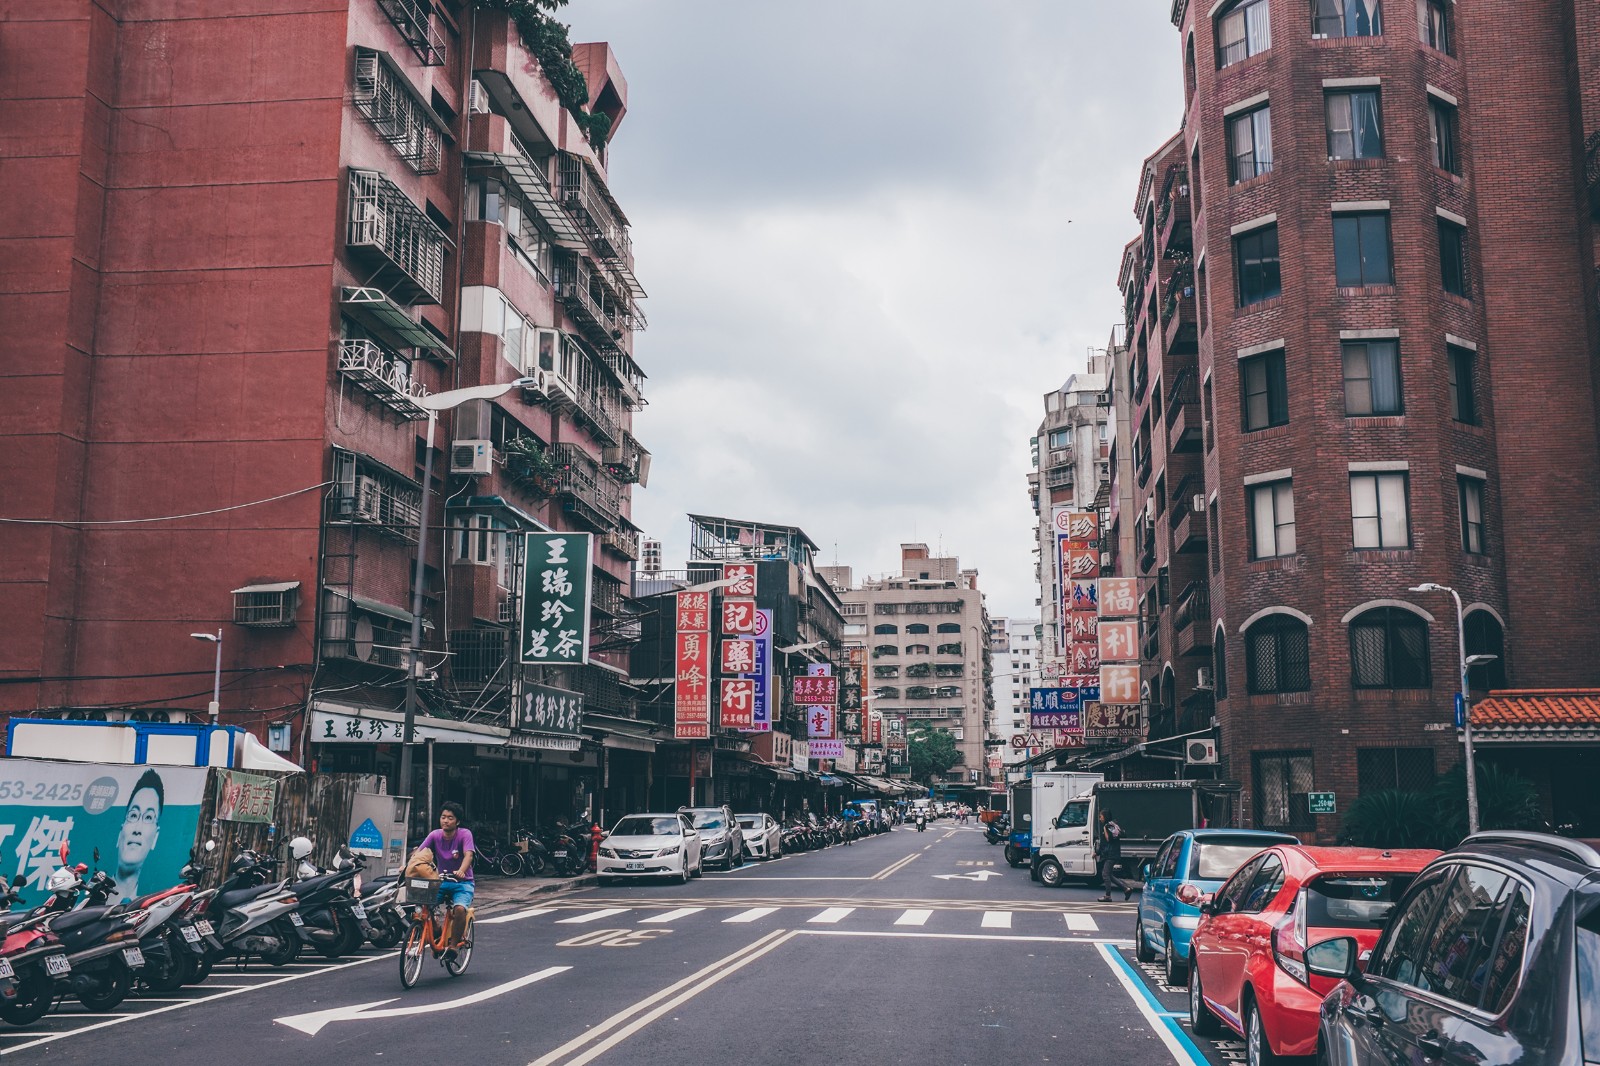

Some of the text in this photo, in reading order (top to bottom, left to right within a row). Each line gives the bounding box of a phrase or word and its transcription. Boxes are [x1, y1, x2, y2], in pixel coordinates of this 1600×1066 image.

[1070, 515, 1097, 573] 珍珍
[541, 538, 574, 628] 王瑞珍
[1073, 585, 1097, 605] 冷凍
[524, 629, 582, 658] 茗茶
[723, 566, 754, 710] 德記藥行
[1104, 582, 1136, 699] 福利行
[679, 634, 705, 693] 勇峰
[1074, 646, 1100, 672] 食品
[525, 692, 575, 730] 王瑞珍茗茶
[1032, 691, 1059, 709] 鼎順
[1086, 701, 1140, 728] 慶豐行
[1032, 714, 1079, 727] 鼎旺食品行
[238, 783, 274, 816] 顏若芳
